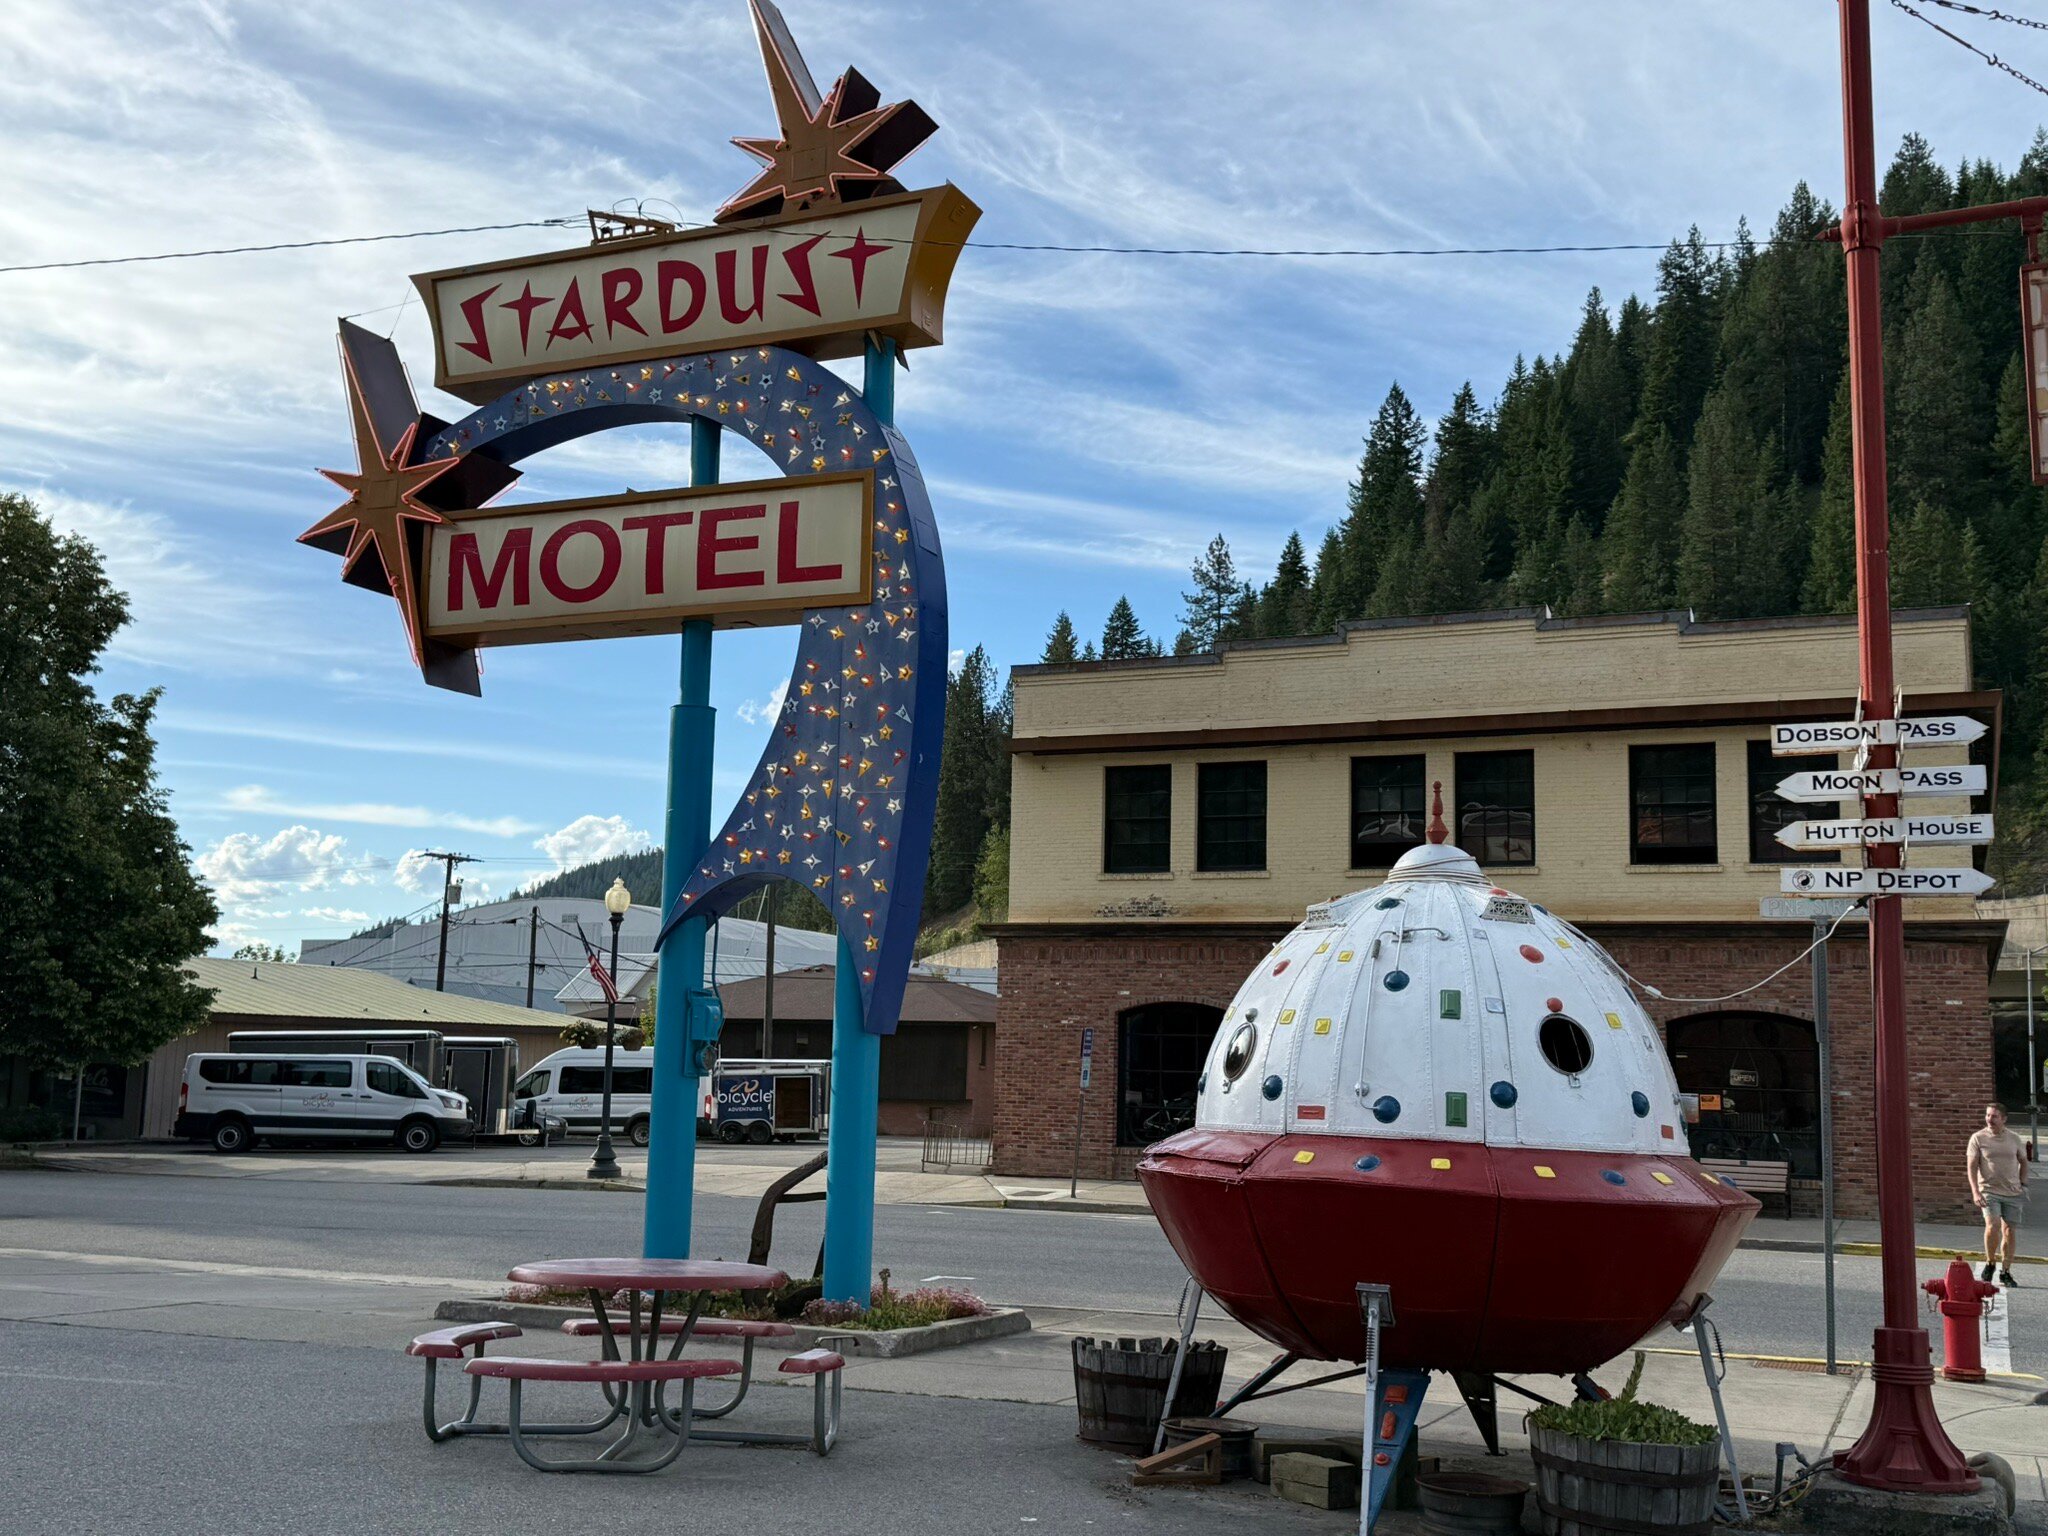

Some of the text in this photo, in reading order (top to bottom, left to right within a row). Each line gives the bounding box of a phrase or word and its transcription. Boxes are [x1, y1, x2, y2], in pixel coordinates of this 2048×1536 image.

[454, 225, 894, 364] STARDUST
[446, 501, 843, 612] MOTEL
[1776, 722, 1956, 744] DOBSON PASS
[1812, 771, 1963, 791] MOON PASS
[1805, 822, 1983, 840] HUTTON HOUSE
[1825, 871, 1863, 888] NP
[1877, 872, 1962, 889] DEPOT
[1768, 899, 1805, 916] PINE
[717, 1089, 773, 1106] bicycle
